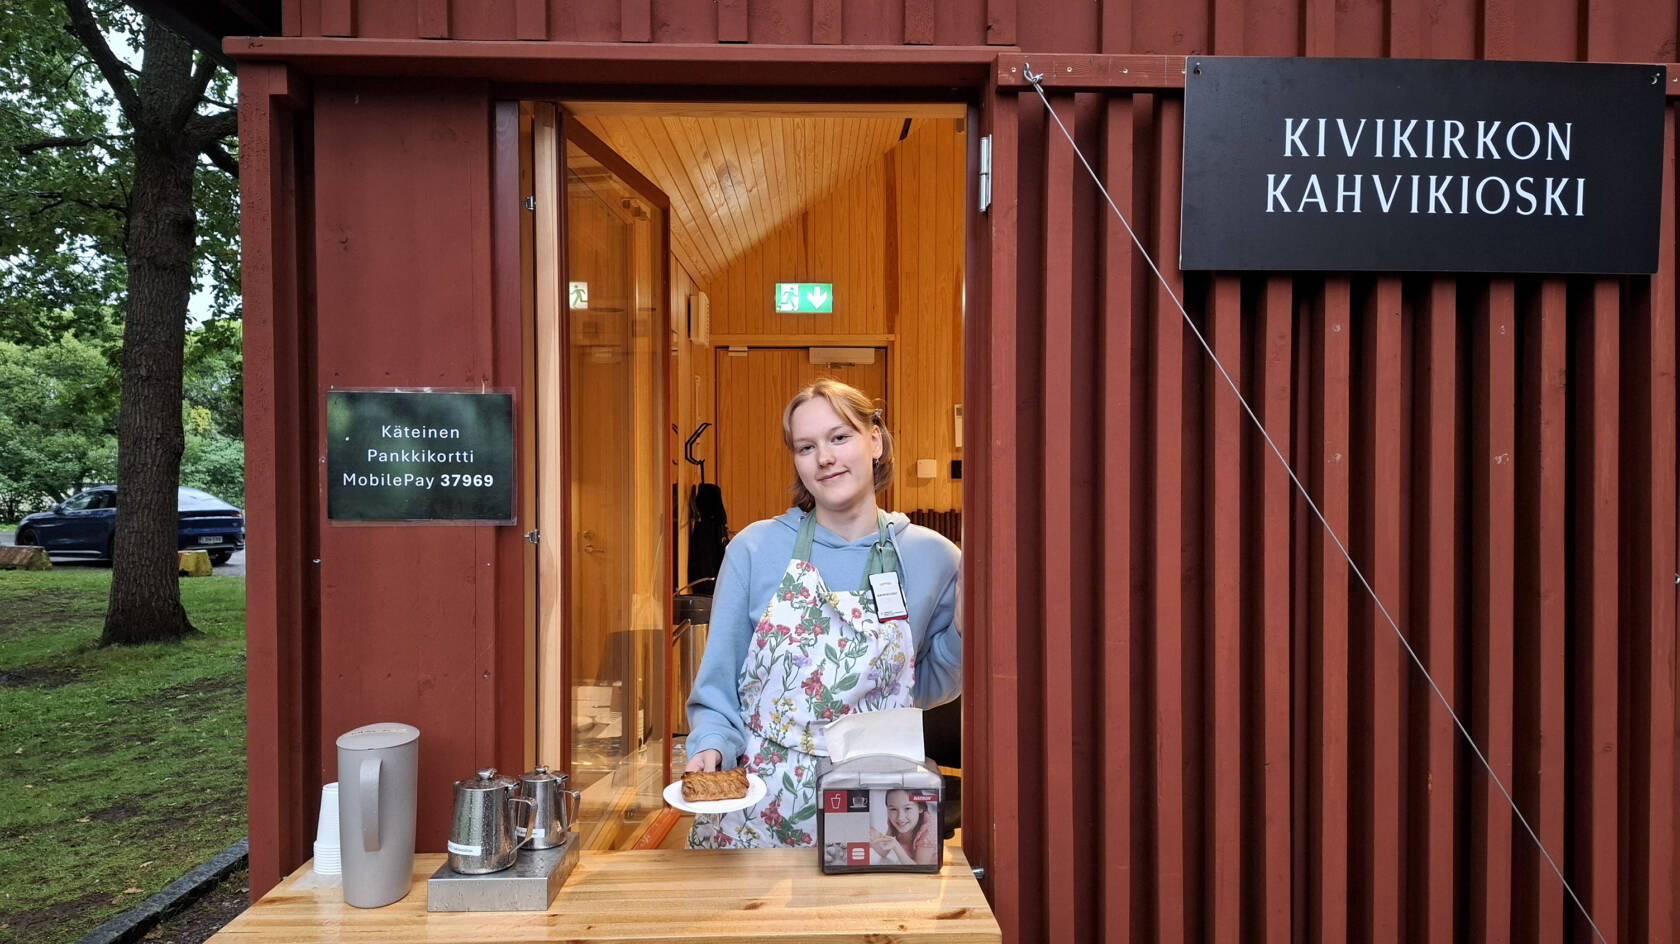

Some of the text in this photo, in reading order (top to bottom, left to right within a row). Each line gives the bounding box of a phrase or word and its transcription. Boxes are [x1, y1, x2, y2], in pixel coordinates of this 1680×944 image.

[1283, 118, 1572, 161] KIVIKIRKON
[1265, 174, 1586, 217] KAHVIKIOSKI
[382, 425, 460, 438] Käteinen
[367, 449, 474, 463] Pankkikortti
[343, 473, 494, 489] MobilePay 37969
